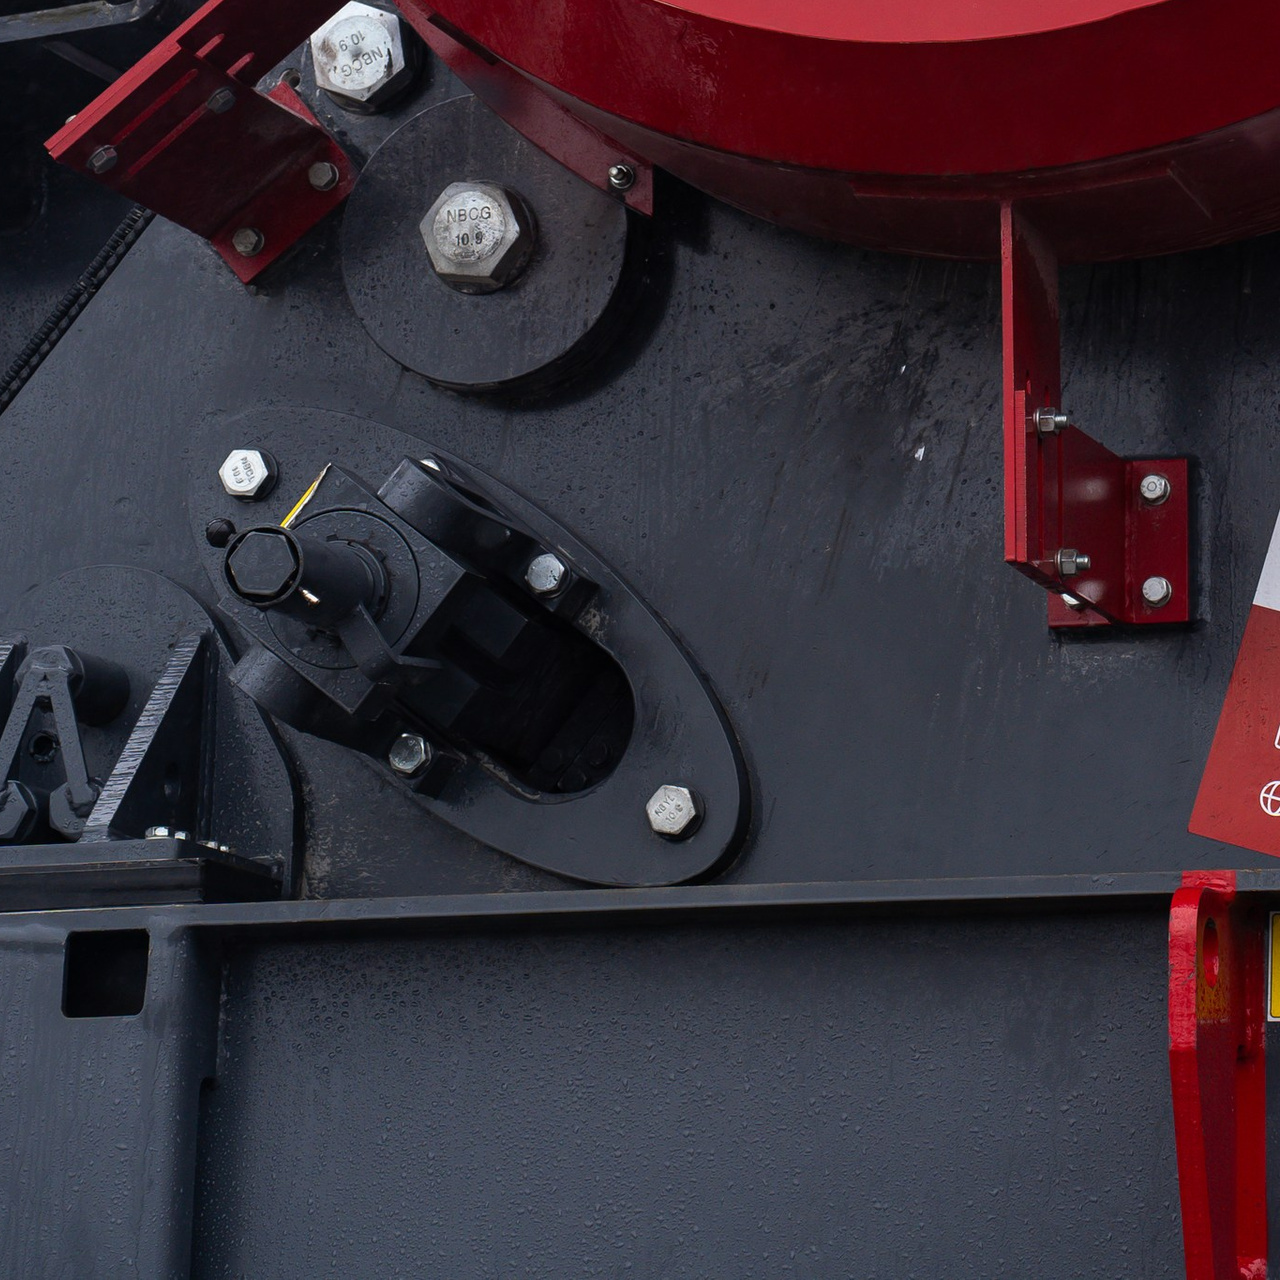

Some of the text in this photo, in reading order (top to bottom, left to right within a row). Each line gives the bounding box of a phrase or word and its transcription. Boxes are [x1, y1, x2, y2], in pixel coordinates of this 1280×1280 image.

[338, 30, 366, 52] 10.9
[341, 46, 384, 78] NBCG
[446, 206, 492, 224] NBCG
